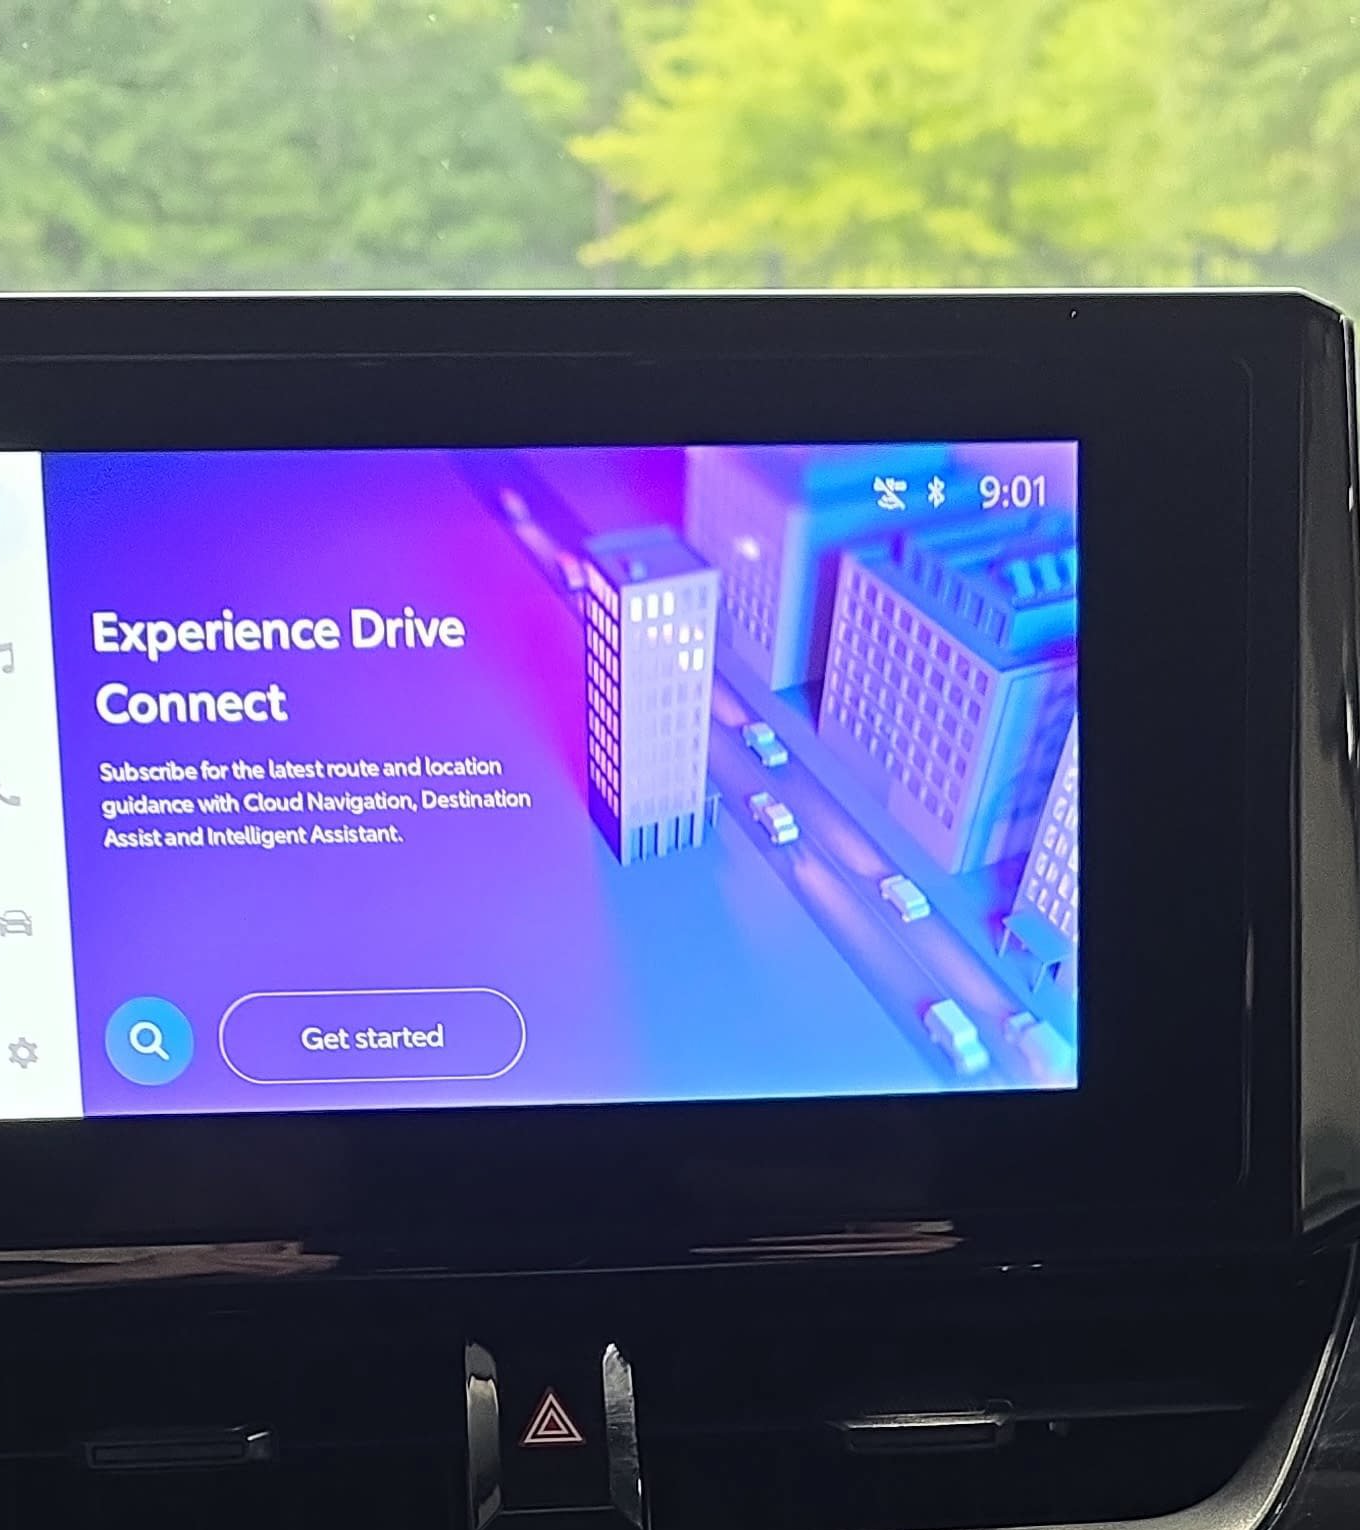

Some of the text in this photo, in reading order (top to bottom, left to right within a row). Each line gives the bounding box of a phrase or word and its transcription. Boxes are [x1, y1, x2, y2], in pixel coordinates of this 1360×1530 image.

[979, 474, 1046, 510] 9:01
[91, 605, 466, 662] Experience Drive
[94, 681, 288, 725] Connect
[99, 755, 502, 783] Subscribe for the latest route and location
[101, 788, 532, 821] guidance with Cloud Navigation, Destination
[103, 824, 404, 850] Assist and Intelligent Assistant.
[300, 1022, 444, 1051] Get started
